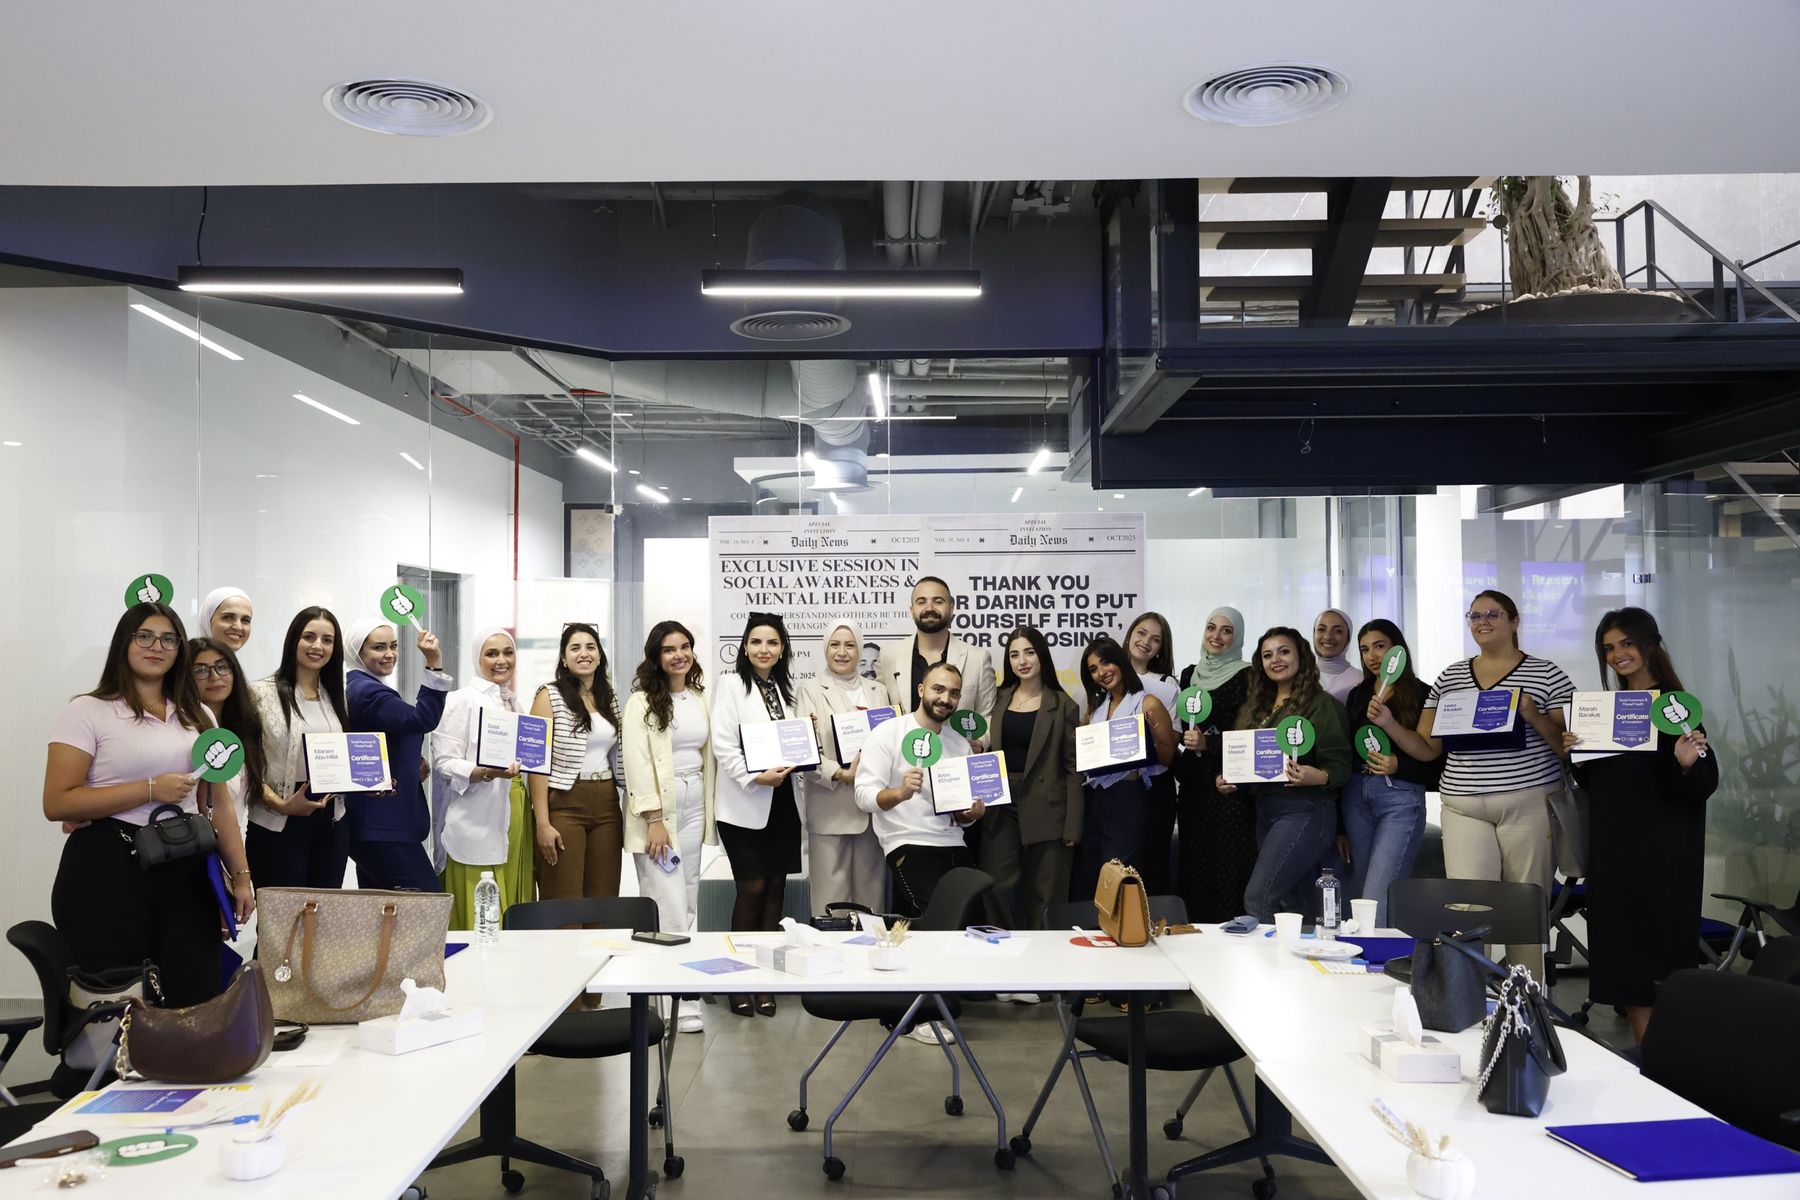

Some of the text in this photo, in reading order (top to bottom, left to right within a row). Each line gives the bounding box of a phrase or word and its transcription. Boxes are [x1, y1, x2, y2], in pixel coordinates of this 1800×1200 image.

[791, 536, 849, 549] Daily News
[1010, 535, 1068, 547] Daily News
[720, 558, 919, 573] EXCLUSIVE SESSION IN
[723, 575, 916, 589] SOCIAL AWARENESS &
[969, 575, 1090, 591] THANK YOU
[745, 591, 895, 605] MENTAL HEALTH
[976, 595, 1055, 610] DARING
[1061, 594, 1091, 609] TO
[1096, 594, 1137, 608] PUT
[1057, 613, 1122, 630] FIRST,
[519, 736, 544, 744] Certificate
